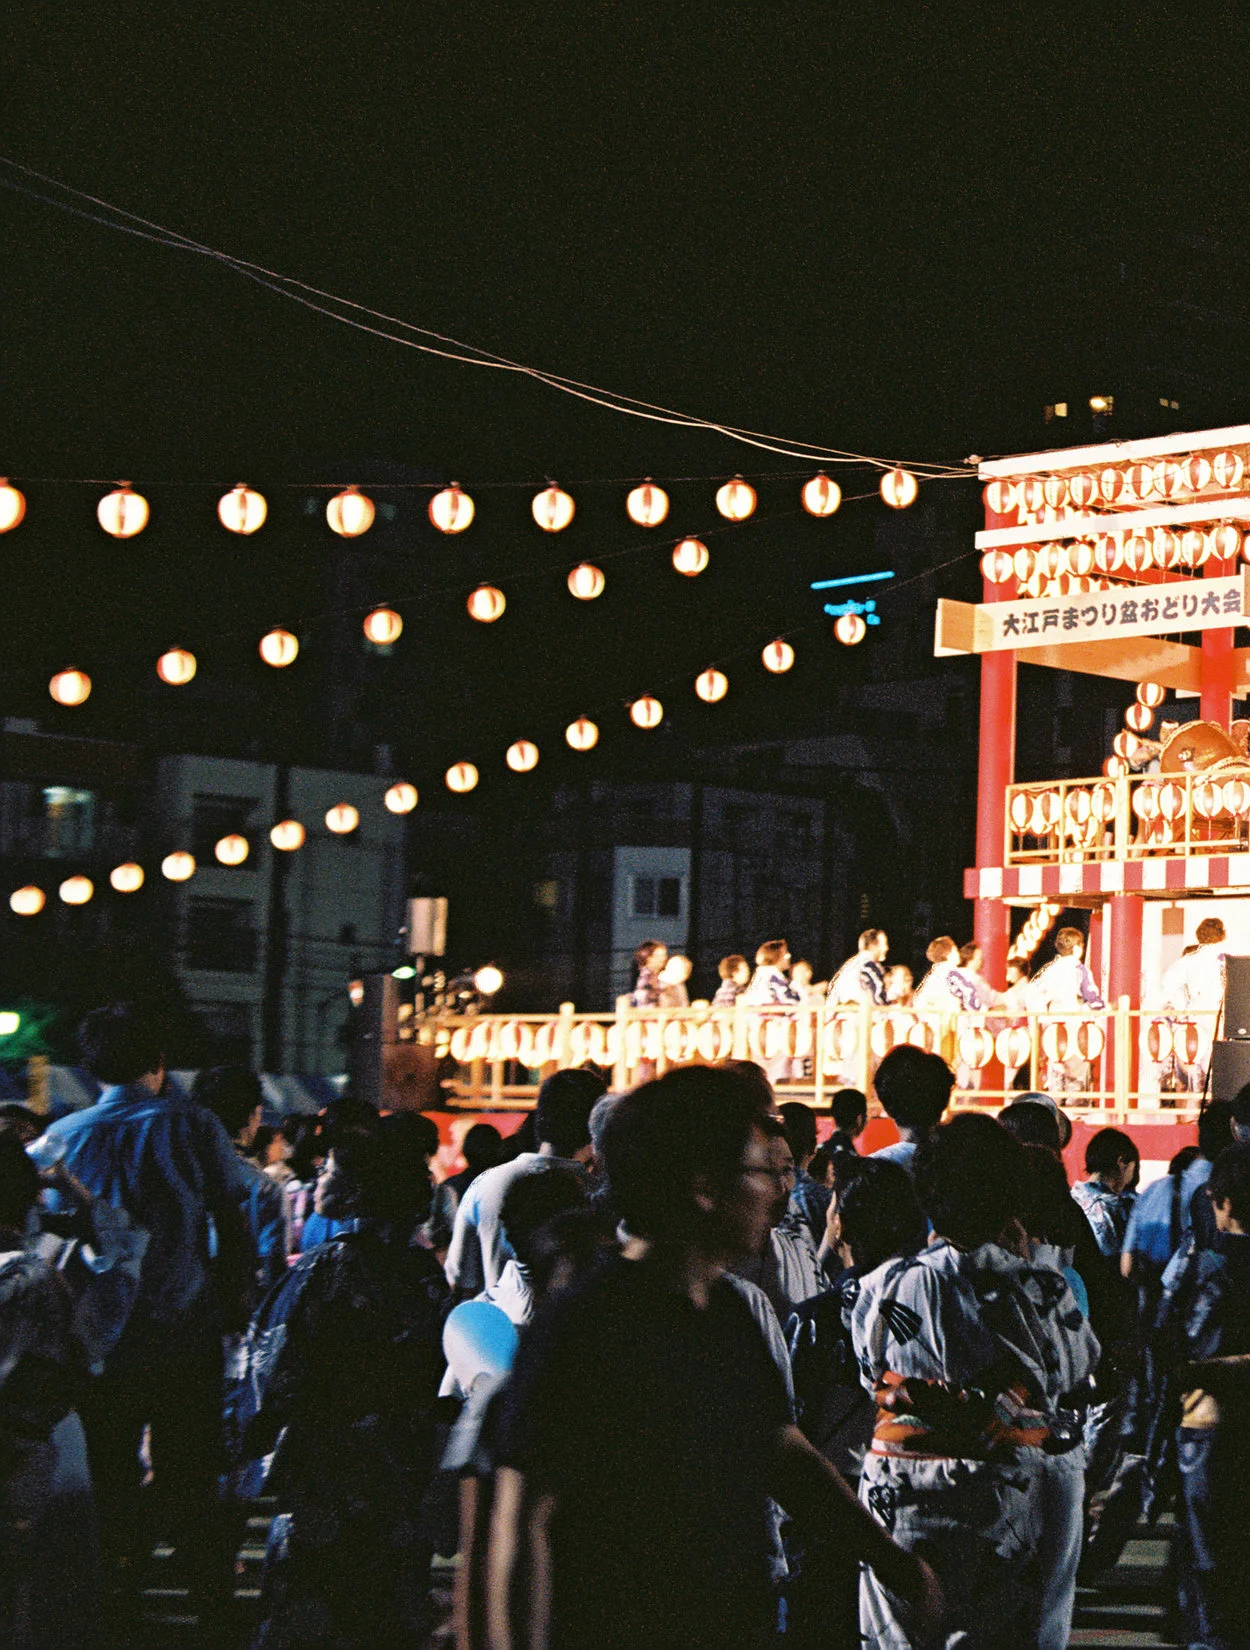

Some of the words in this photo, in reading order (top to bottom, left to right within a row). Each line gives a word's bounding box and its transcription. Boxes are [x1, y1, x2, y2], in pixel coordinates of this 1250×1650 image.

[1003, 588, 1241, 637] 大江戸まつり盆おどり大会
